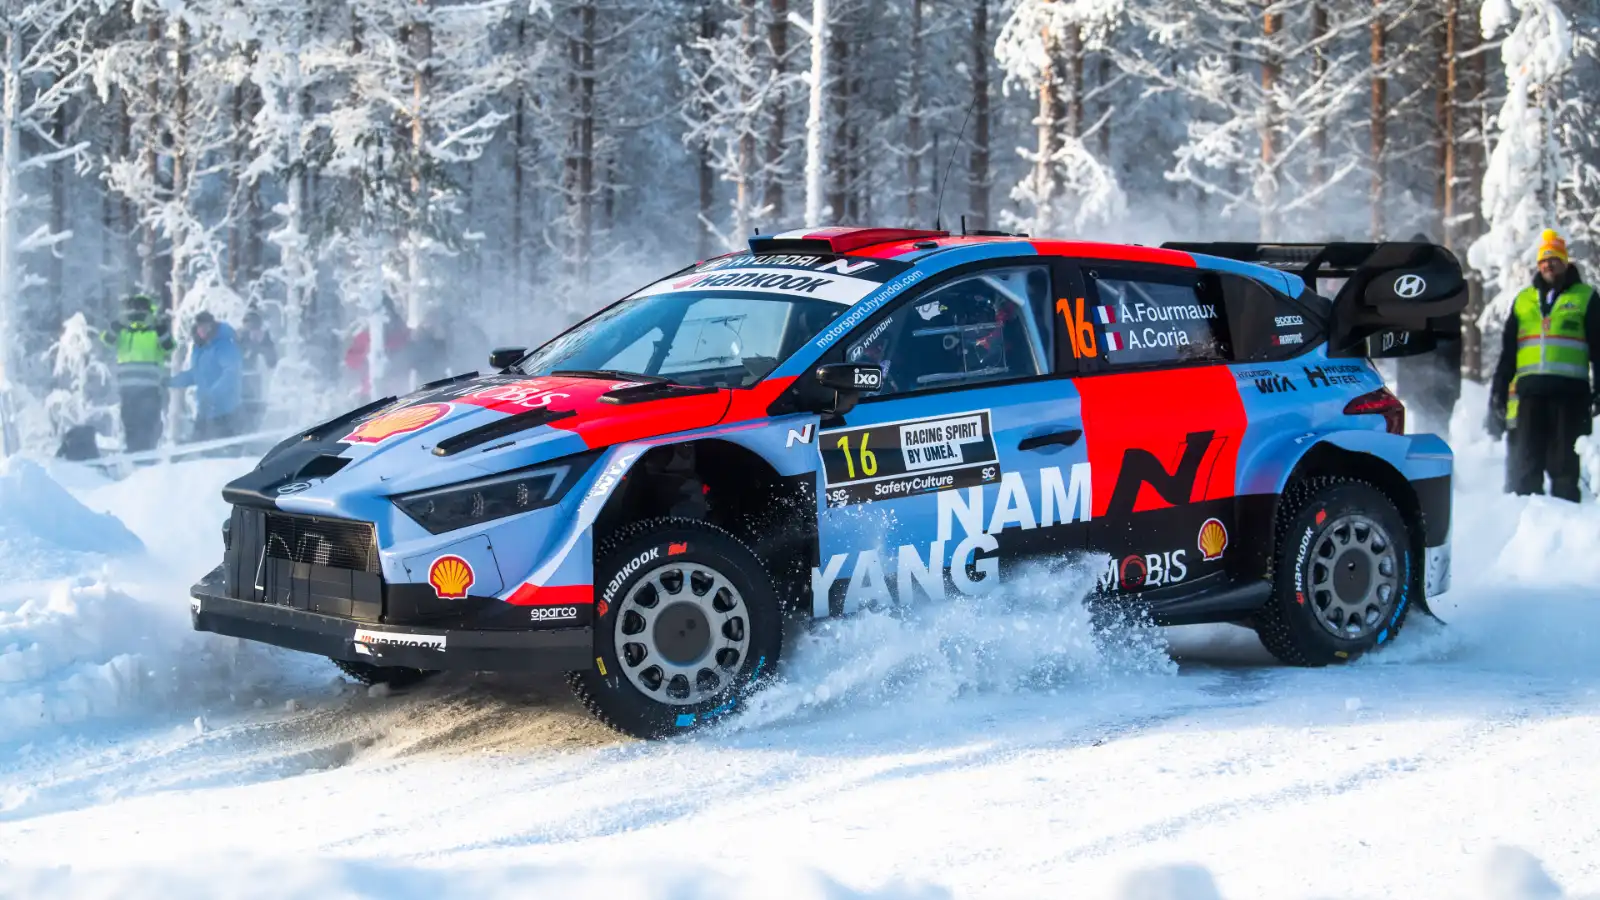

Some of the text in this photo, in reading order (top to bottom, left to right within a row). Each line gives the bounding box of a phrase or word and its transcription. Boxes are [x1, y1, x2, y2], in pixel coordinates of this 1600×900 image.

[816, 269, 924, 349] motorsport.hyundai.com
[1121, 303, 1218, 324] A.Fourmaux
[1274, 315, 1304, 327] sparco
[1056, 297, 1098, 358] 16
[1129, 324, 1190, 350] A.Coria
[1330, 375, 1362, 385] STEEL
[905, 422, 978, 446] RACING SPIRIT
[837, 432, 878, 478] 16
[908, 449, 921, 464] BY
[874, 474, 954, 496] SafetyCulture
[937, 462, 1092, 541] NAM
[811, 533, 999, 619] YANG
[1101, 549, 1187, 592] MOBIS
[530, 606, 577, 621] sparco
